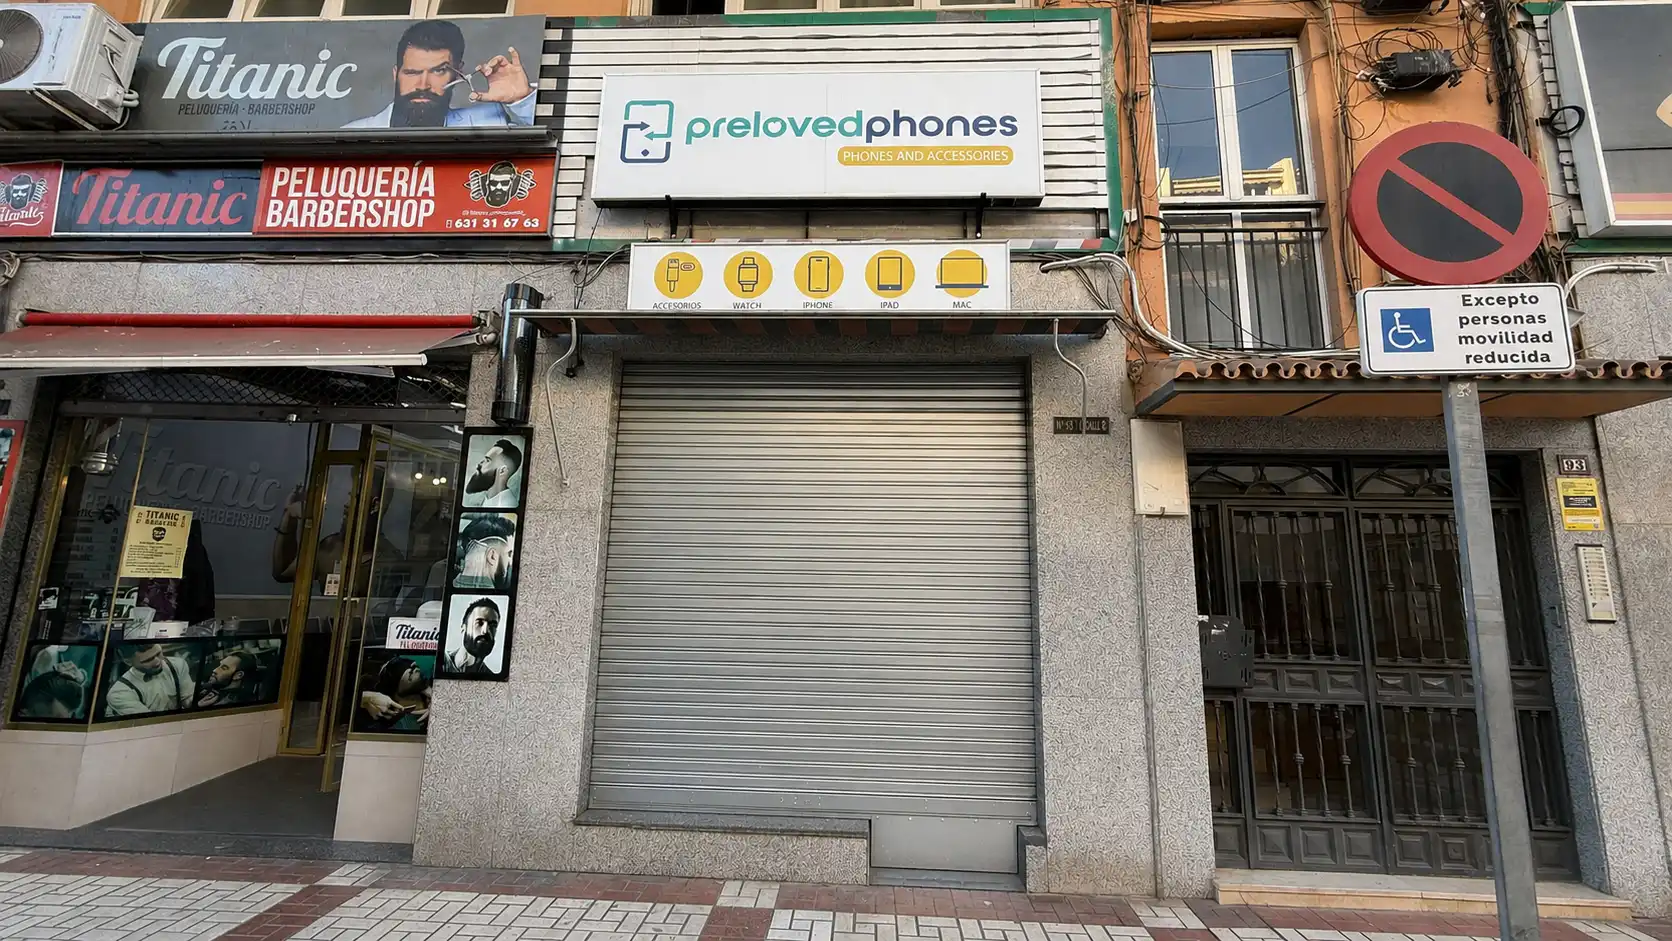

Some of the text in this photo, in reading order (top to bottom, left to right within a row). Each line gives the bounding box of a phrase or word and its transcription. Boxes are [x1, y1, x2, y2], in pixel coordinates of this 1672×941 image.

[157, 37, 358, 100] Titanic
[178, 101, 316, 115] PELUQUERÍA BARBERSHOP
[685, 109, 1019, 145] prelovedphones
[843, 150, 1008, 162] PHONES AND ACCESSORIES
[271, 160, 435, 199] PELUQUERÍA
[72, 168, 248, 226] Titanic
[265, 199, 435, 228] BARBERSHOP
[454, 218, 540, 229] 631 31 67 63
[652, 302, 702, 310] ACCESORIOS
[802, 301, 833, 309] IPHONE
[880, 301, 900, 309] IPAD
[952, 301, 972, 309] MAC
[1461, 293, 1539, 308] Excepto
[1458, 313, 1547, 328] personas
[1458, 331, 1553, 346] movilidad
[1464, 350, 1551, 364] reducida
[1565, 460, 1584, 470] 93
[146, 510, 180, 521] TITANIC
